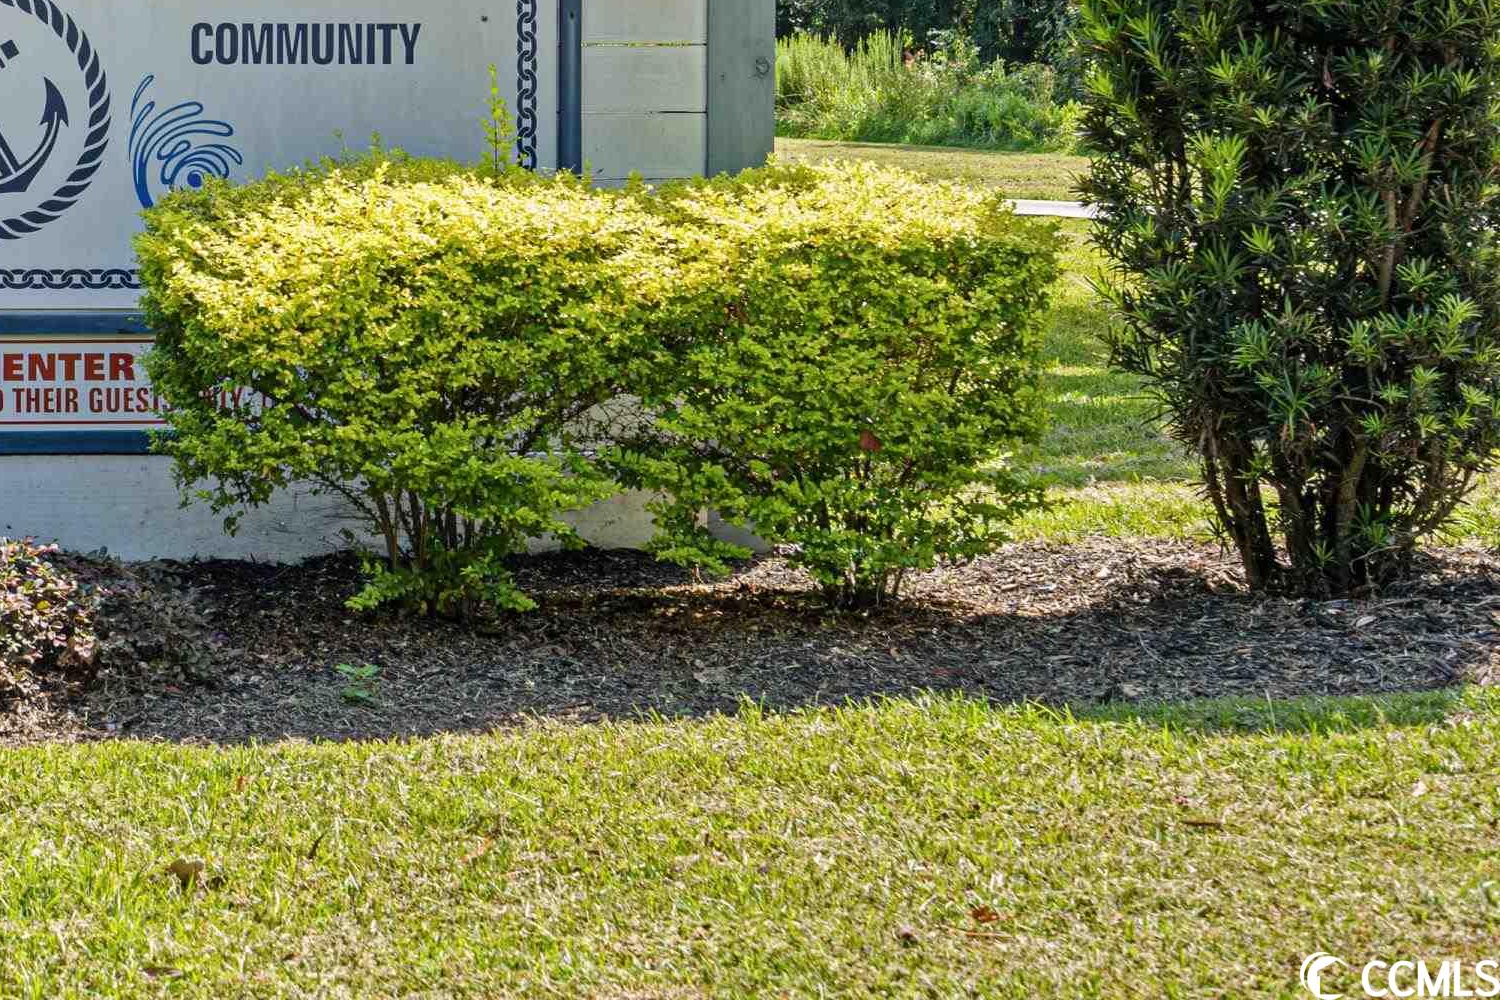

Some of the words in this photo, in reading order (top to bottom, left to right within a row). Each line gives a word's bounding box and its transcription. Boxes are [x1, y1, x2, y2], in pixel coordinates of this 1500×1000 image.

[190, 22, 422, 65] COMMUNITY
[3, 352, 136, 381] ENTER
[11, 387, 79, 413] THEIR
